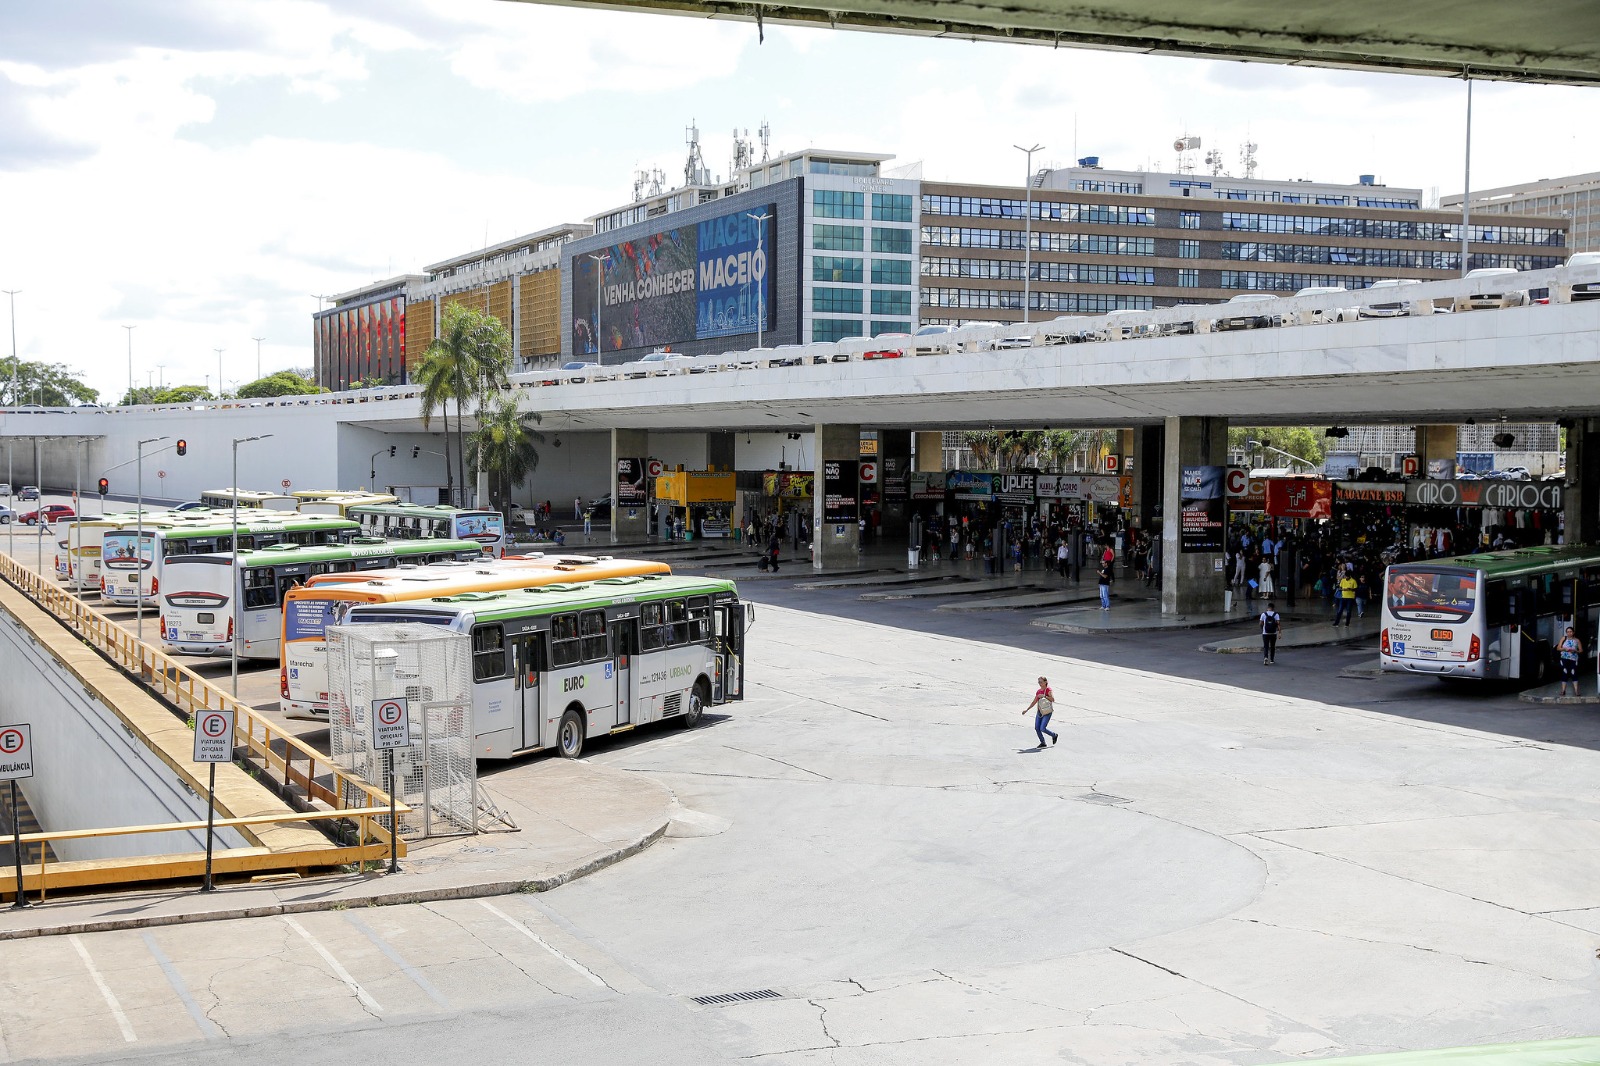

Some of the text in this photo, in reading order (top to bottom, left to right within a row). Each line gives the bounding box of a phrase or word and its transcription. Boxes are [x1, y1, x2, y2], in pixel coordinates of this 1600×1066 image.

[853, 177, 894, 186] BOULEVARD
[603, 268, 695, 306] VENHA CONHECER
[649, 461, 661, 475] C
[1107, 457, 1116, 469] D
[1405, 459, 1416, 473] D
[860, 463, 874, 481] C
[1001, 475, 1034, 493] UPLIFE
[1227, 470, 1245, 493] C
[1336, 489, 1404, 501] MAGAZINE BSB
[1416, 482, 1560, 508] GIRO CARIOCA
[351, 549, 368, 557] MOVIDO
[372, 547, 395, 555] BIODIESEL
[1390, 633, 1412, 641] 119822
[669, 664, 692, 679] URBANO
[563, 675, 585, 692] EURO
[386, 707, 395, 720] E
[210, 719, 220, 732] E
[5, 734, 16, 749] E
[379, 732, 403, 740] OFICIAIS
